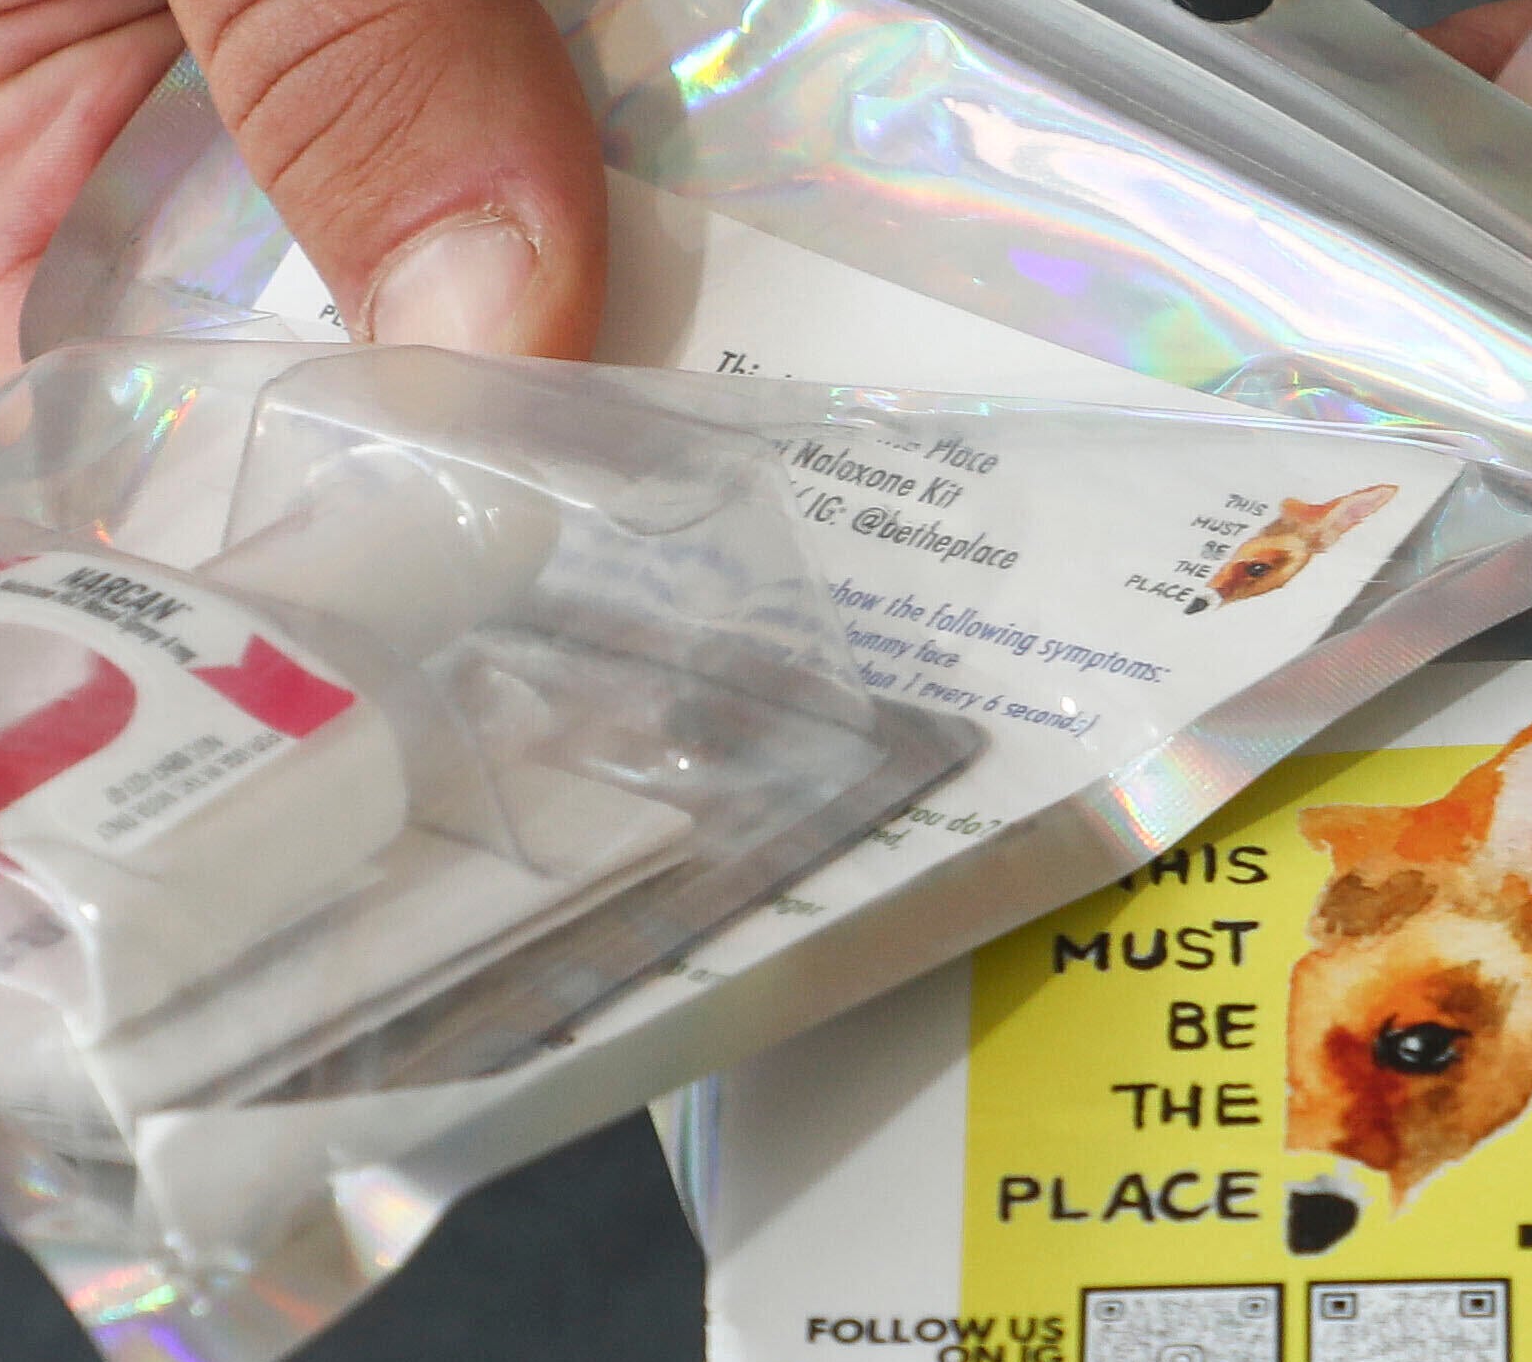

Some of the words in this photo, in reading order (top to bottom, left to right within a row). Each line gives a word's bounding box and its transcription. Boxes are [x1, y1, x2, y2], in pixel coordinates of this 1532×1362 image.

[791, 438, 916, 497] Naloxone
[918, 476, 964, 509] Kit
[1225, 494, 1268, 518] THIS
[852, 505, 1020, 570] @betheplace
[1191, 515, 1249, 537] MUST
[1201, 540, 1231, 558] BE
[1124, 574, 1195, 603] PLACE
[1174, 559, 1213, 580] THE
[884, 594, 925, 621] the
[926, 603, 1039, 656] following
[1037, 638, 1171, 683] symptoms:
[915, 639, 961, 668] face
[919, 681, 982, 710] every
[983, 695, 1005, 712] 6
[1118, 842, 1269, 892] HIS
[1053, 919, 1260, 974] MUST
[1168, 1001, 1258, 1050] BE
[1111, 1083, 1262, 1131] THE
[1000, 1171, 1261, 1223] PLACE
[805, 1317, 995, 1344] FOLLOW
[1009, 1317, 1065, 1343] US
